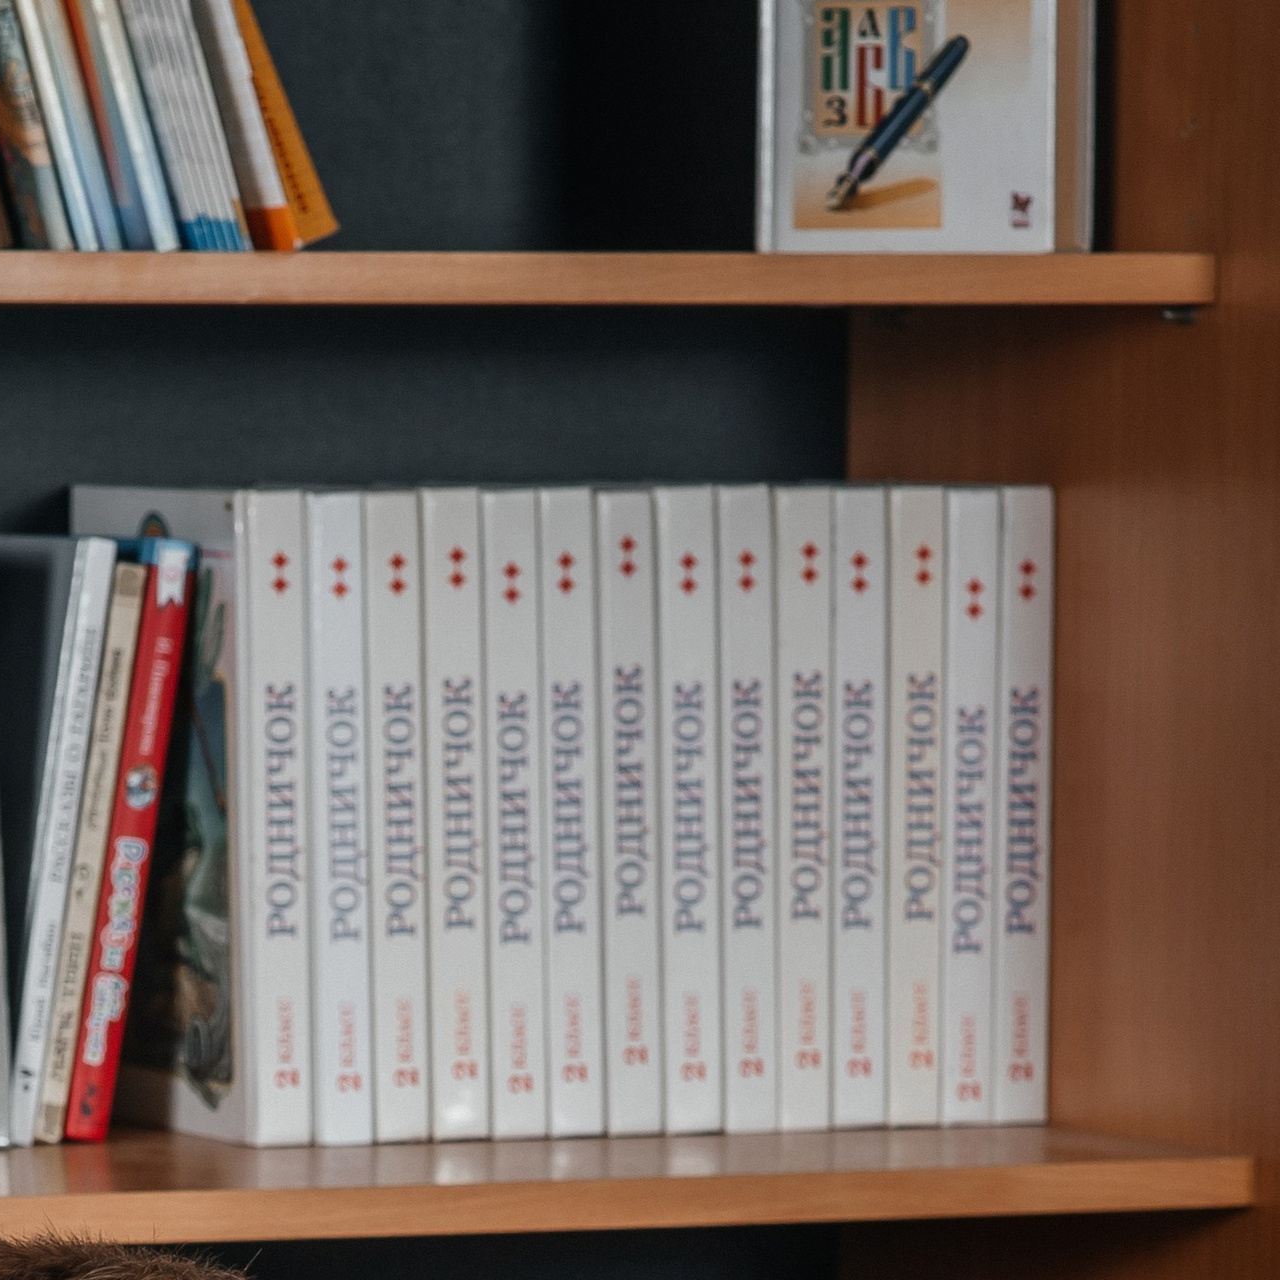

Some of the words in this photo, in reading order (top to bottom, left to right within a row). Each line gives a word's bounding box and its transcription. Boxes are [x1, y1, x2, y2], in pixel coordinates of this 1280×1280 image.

[265, 680, 303, 940] РОДНИЧОК
[326, 685, 368, 942] РОДНИЧОК
[383, 681, 424, 938] РОДНИЧОК
[442, 676, 481, 930] РОДНИЧОК
[498, 691, 535, 945] РОДНИЧОК
[552, 681, 590, 934] РОДНИЧОК
[614, 663, 650, 918] РОДНИЧОК
[674, 681, 709, 932] РОДНИЧОК
[731, 679, 767, 929] РОДНИЧОК
[791, 670, 827, 921] РОДНИЧОК
[841, 679, 878, 930] РОДНИЧОК
[905, 671, 941, 921] РОДНИЧОК
[952, 704, 987, 954] РОДНИЧОК
[1005, 686, 1041, 935] РОДНИЧОК
[273, 1067, 301, 1090] 2
[335, 1071, 362, 1093] 2
[393, 1066, 420, 1089] 2
[451, 1058, 479, 1081] 2
[508, 1073, 534, 1094] 2
[561, 1061, 589, 1082] 2
[622, 1043, 649, 1066] 2
[680, 1060, 707, 1081] 2
[738, 1056, 764, 1078] 2
[794, 1047, 821, 1070] 2
[845, 1056, 873, 1078] 2
[907, 1048, 935, 1070] 2
[956, 1080, 983, 1102] 2
[1007, 1060, 1034, 1082] 2
